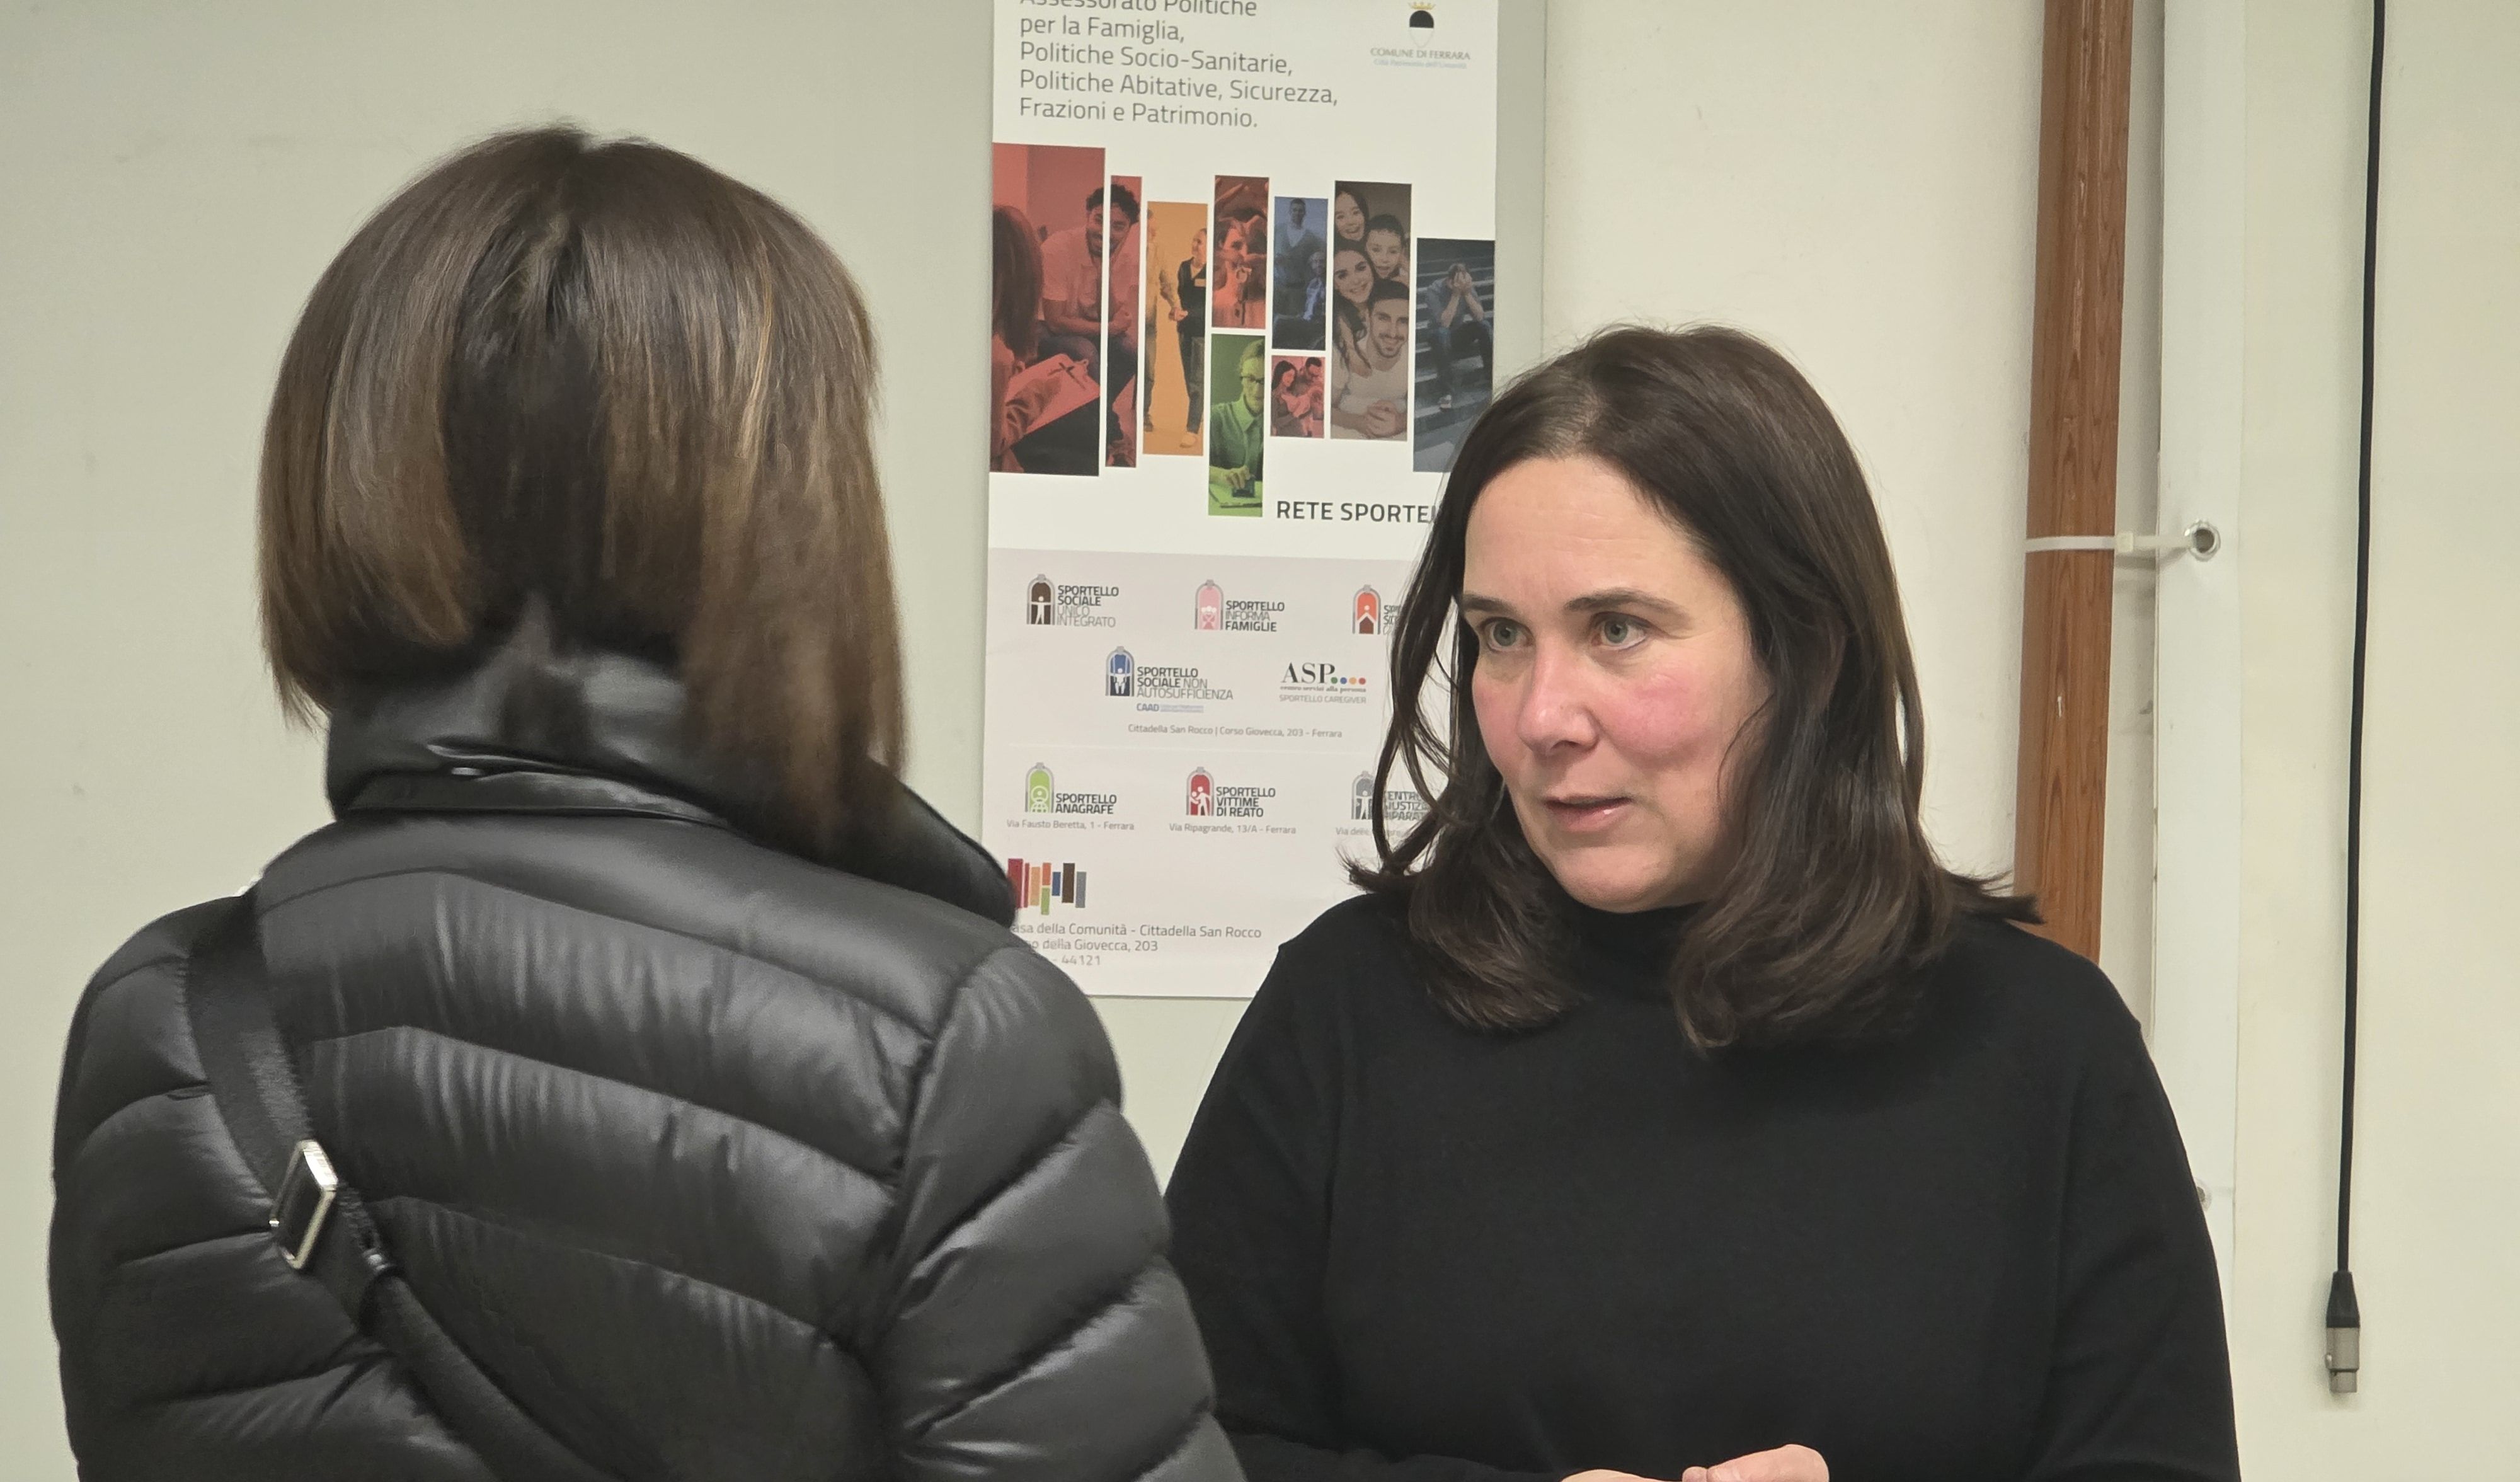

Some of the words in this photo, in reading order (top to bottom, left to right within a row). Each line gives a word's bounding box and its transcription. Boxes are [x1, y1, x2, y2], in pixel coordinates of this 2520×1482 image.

[1020, 0, 1156, 11] essorato
[1164, 0, 1257, 16] Politiche
[1020, 18, 1055, 37] per
[1062, 15, 1080, 35] la
[1088, 16, 1185, 45] Famiglia,
[1021, 41, 1114, 65] Politiche
[1121, 47, 1293, 76] Socio-Sanitarie,
[1370, 47, 1413, 58] COMUNE
[1416, 50, 1427, 58] DI
[1429, 50, 1470, 60] FERRARA
[1021, 69, 1113, 93] Politiche
[1120, 74, 1223, 101] Abitative,
[1230, 79, 1337, 106] Sicurezza,
[1020, 97, 1105, 120] Frazioni
[1113, 107, 1125, 121] e
[1132, 103, 1257, 127] Patrimonio.
[1276, 500, 1334, 520] RETE
[1058, 585, 1119, 597] SPORTELLO
[1058, 595, 1101, 606] SOCIALE
[1226, 600, 1285, 612] SPORTELLO
[1057, 606, 1090, 617] UNICO
[1225, 611, 1270, 621] INFORMA
[1057, 615, 1116, 628] INTEGRATO
[1225, 621, 1277, 632] FAMIGLIE
[1137, 666, 1198, 678] SPORTELLO
[1281, 662, 1335, 684] ASP
[1137, 677, 1181, 688] SOCIALE
[1183, 678, 1208, 689] NON
[1137, 687, 1234, 700] AUTOSUFFICIENZA
[1280, 694, 1323, 703] SPORTELLO
[1324, 695, 1366, 704] CAREGIVER
[1137, 703, 1159, 711] CAAD
[1128, 724, 1167, 733] Cittadella
[1170, 725, 1186, 733] San
[1188, 725, 1213, 734] Rocco
[1220, 727, 1244, 735] Corso
[1246, 727, 1285, 737] Giovecca,
[1287, 728, 1303, 737] 203
[1312, 728, 1342, 738] Ferrara
[1216, 786, 1276, 798] SPORTELLO
[1056, 793, 1117, 804] SPORTELLO
[1217, 796, 1259, 807] VITTIME
[1055, 803, 1114, 815] ANAGRAFE
[1217, 807, 1227, 817] DI
[1229, 807, 1264, 817] REATO
[1022, 820, 1051, 829] Fausto
[1053, 820, 1087, 830] Beretta,
[1104, 822, 1134, 830] Ferrara
[1169, 823, 1182, 831] Via
[1184, 823, 1234, 834] Ripagrande,
[1237, 825, 1257, 833] 13/A
[1266, 825, 1297, 834] Ferrara
[1012, 924, 1034, 933] asa
[1037, 922, 1065, 934] della
[1069, 923, 1127, 935] Comunità
[1140, 924, 1196, 937] Cittadella
[1200, 926, 1222, 937] San
[1225, 926, 1261, 938] Rocco
[1043, 938, 1071, 950] della
[1074, 939, 1131, 953] Giovecca,
[1135, 940, 1158, 951] 203
[1062, 955, 1101, 966] 44121
